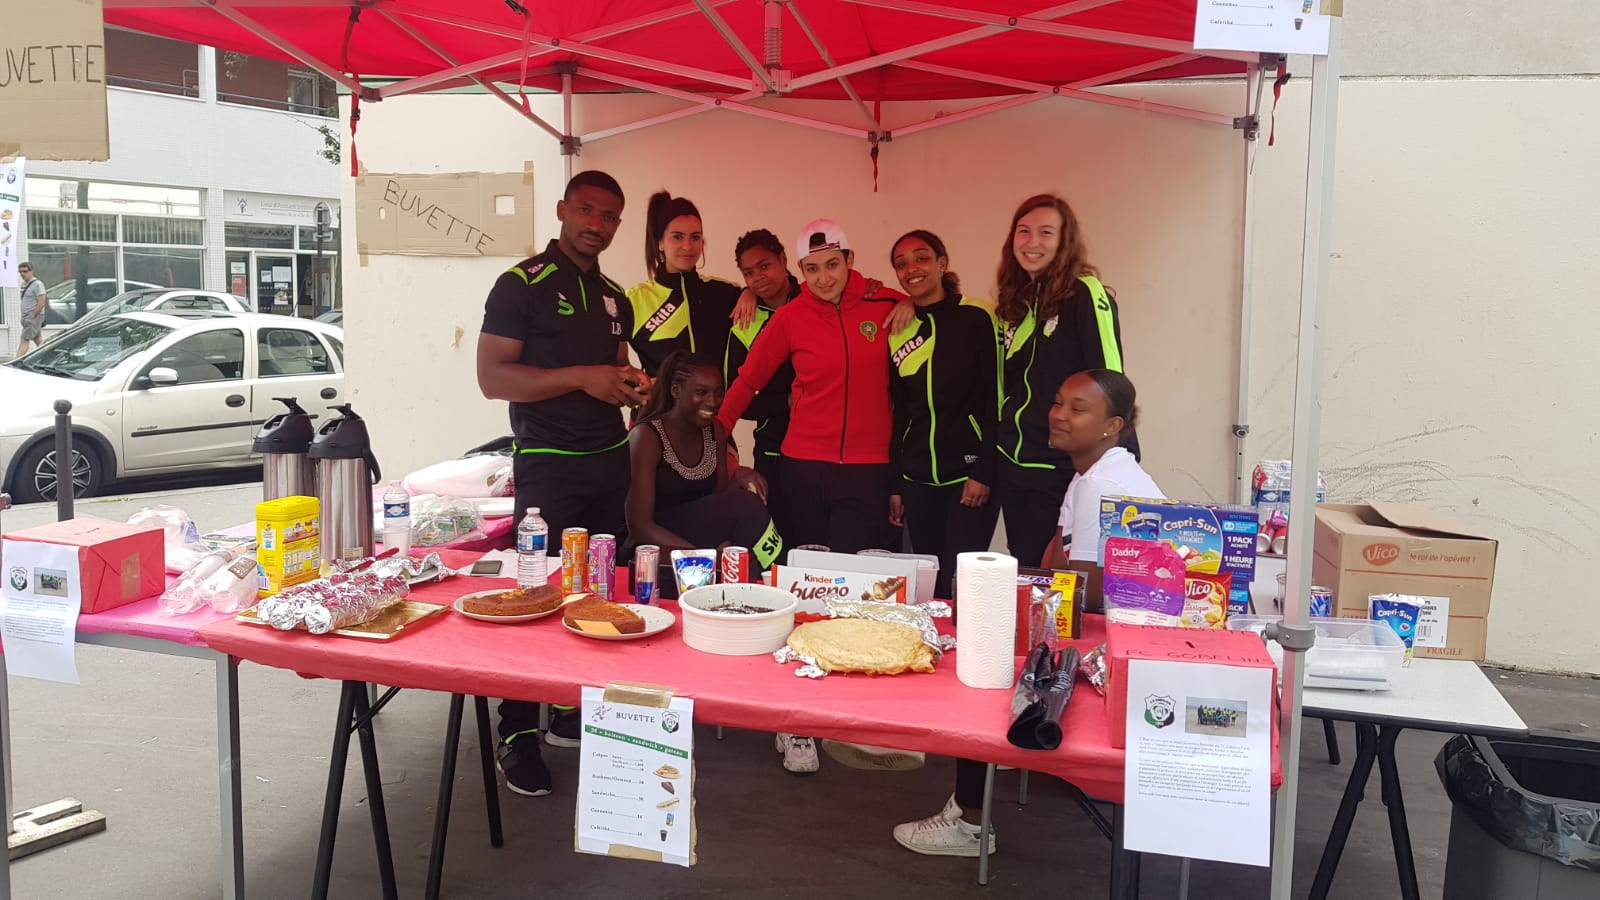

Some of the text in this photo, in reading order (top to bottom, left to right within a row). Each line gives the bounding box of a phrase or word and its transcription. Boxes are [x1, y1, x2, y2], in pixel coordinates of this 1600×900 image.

[0, 45, 102, 87] UVETTE
[383, 180, 495, 255] BUVETTE
[645, 302, 676, 332] Skita
[891, 335, 924, 367] Skita
[1162, 517, 1218, 534] Capri-Sun
[1233, 536, 1253, 544] PACK
[1111, 548, 1140, 558] Daddy
[1229, 556, 1253, 564] HEURE
[1366, 545, 1398, 561] Vico
[790, 581, 849, 600] bueno
[1377, 608, 1413, 621] Capri-Sun
[1427, 647, 1463, 656] FRAGILE
[616, 711, 655, 723] BUVETTE
